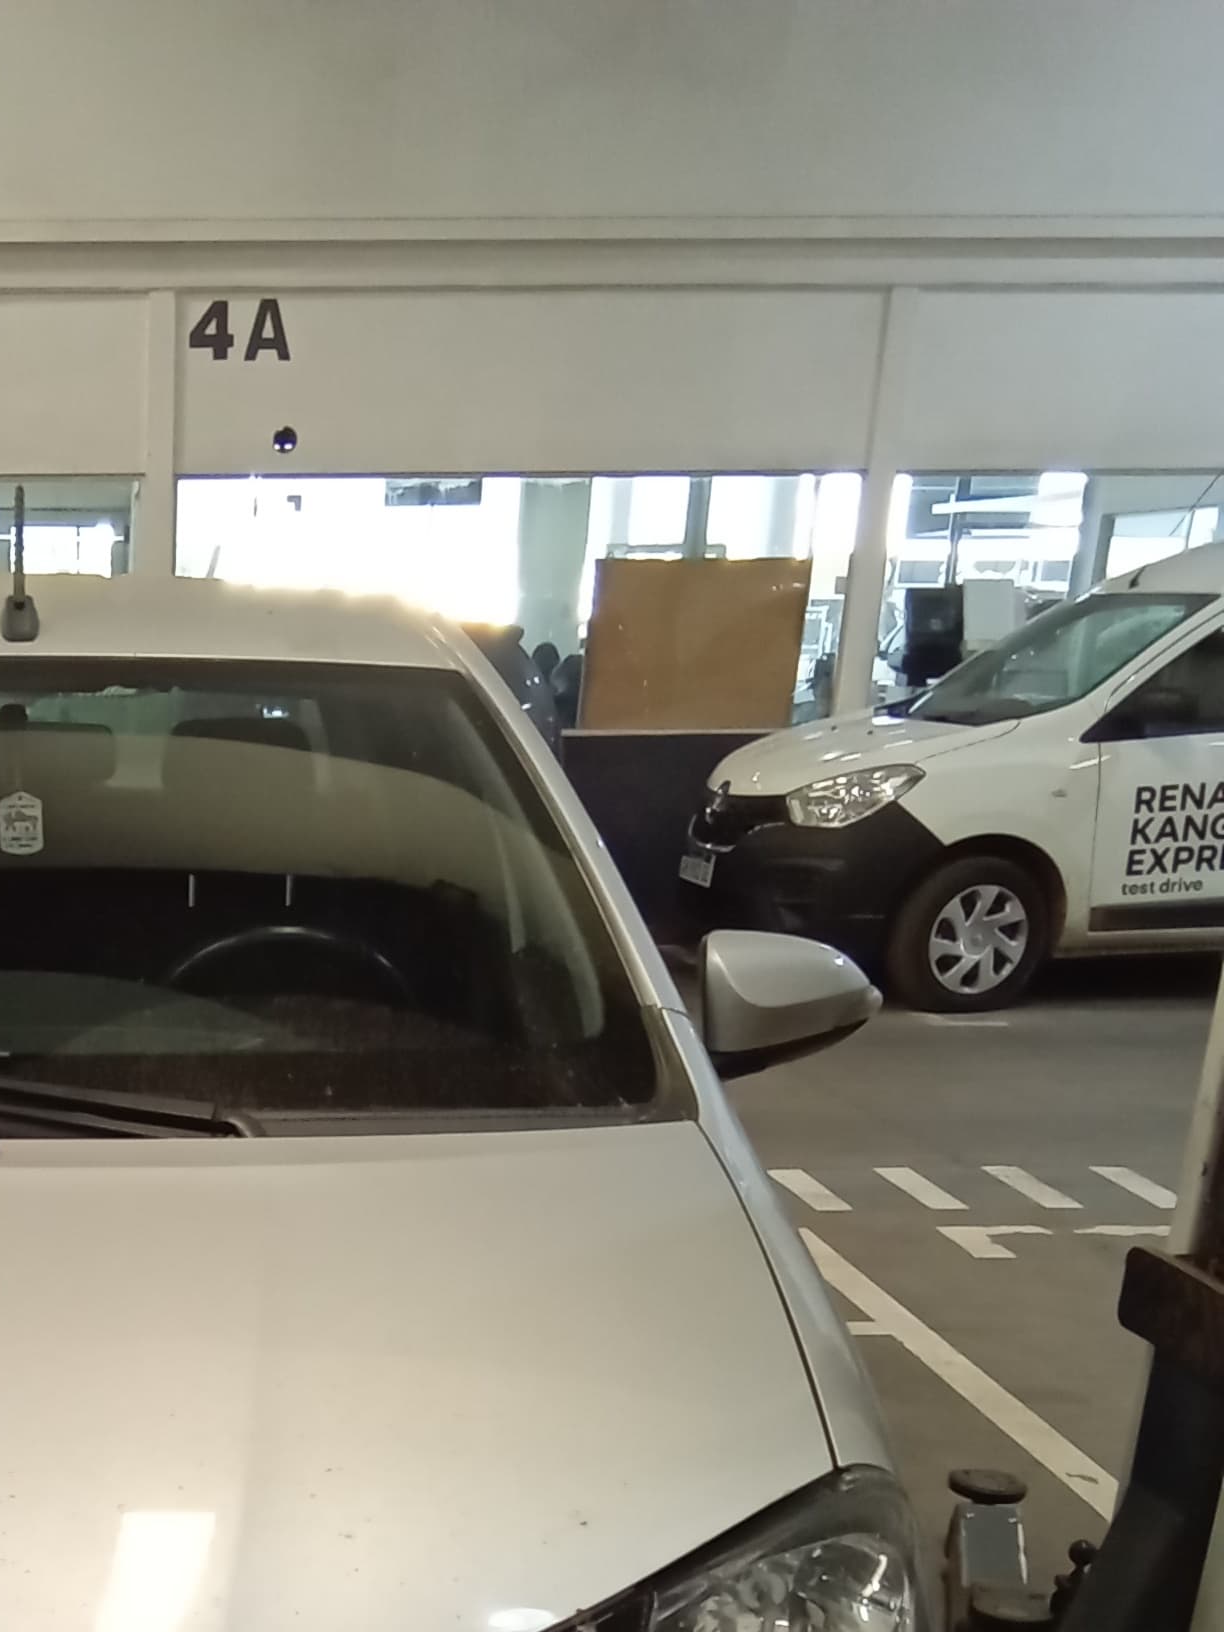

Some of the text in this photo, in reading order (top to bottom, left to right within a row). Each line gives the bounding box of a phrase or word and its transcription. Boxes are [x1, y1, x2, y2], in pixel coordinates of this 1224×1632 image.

[189, 298, 291, 361] 4A
[1126, 845, 1224, 876] EXPR
[1121, 878, 1204, 895] test drive
